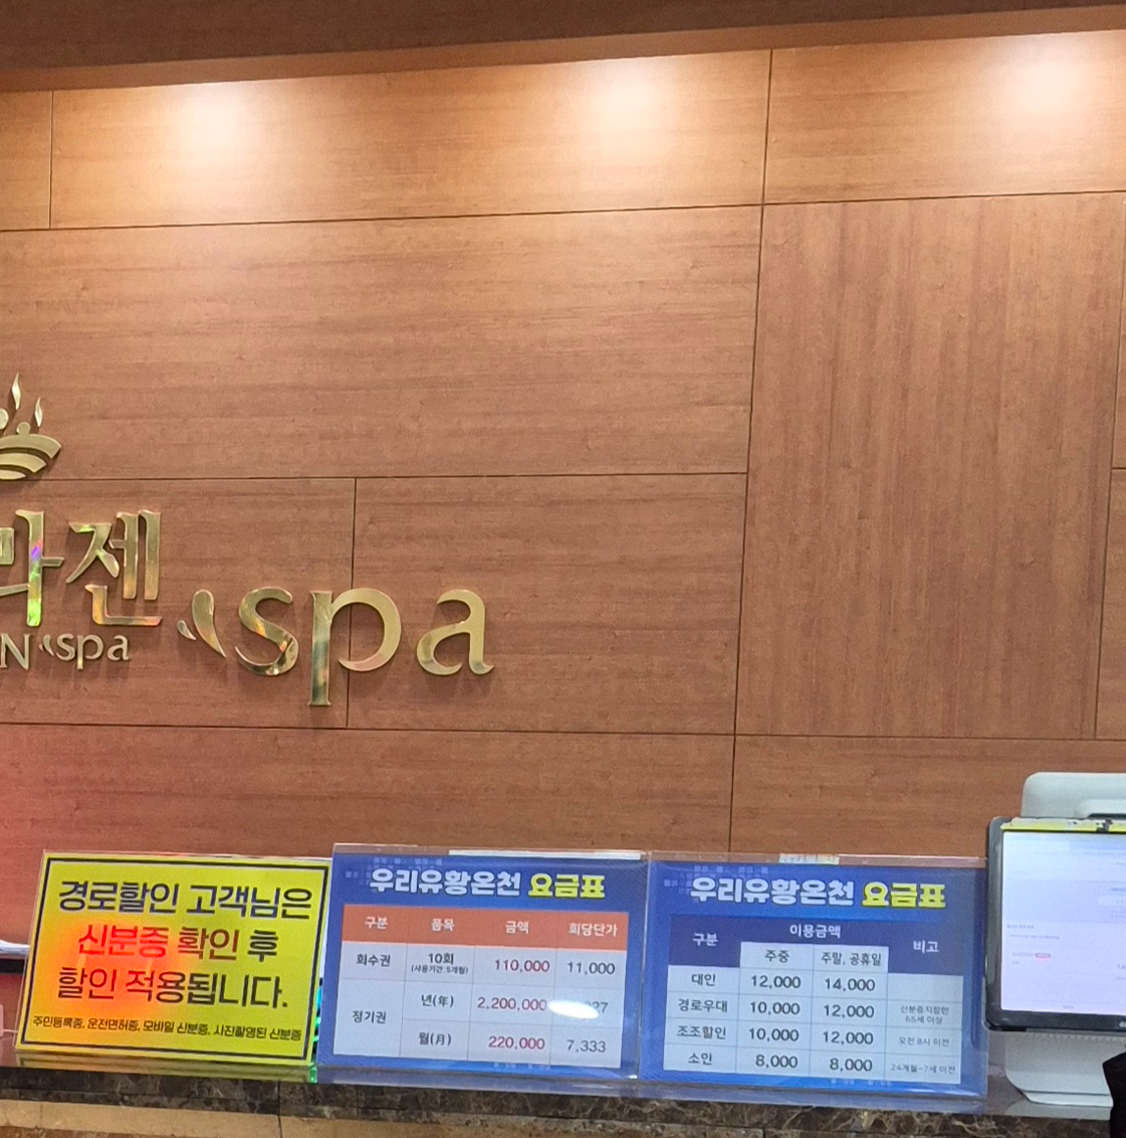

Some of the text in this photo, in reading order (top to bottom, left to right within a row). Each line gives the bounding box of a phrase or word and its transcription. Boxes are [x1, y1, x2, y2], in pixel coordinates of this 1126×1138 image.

[234, 586, 495, 707] spa
[369, 867, 606, 899] 우리유황온천 요금표
[690, 876, 947, 909] 우리유황온천 요금표
[59, 880, 313, 920] 경로할인 고객님은
[364, 916, 618, 937] 구분 품목 금액 회당단가
[789, 923, 842, 939] 이용금액
[78, 924, 278, 962] 신분증 확인 후
[692, 932, 939, 954] 구분 비고
[355, 952, 616, 976] 회수권 10회 110,000 11,000
[764, 949, 882, 967] 주중 주말, 공휴일
[58, 967, 288, 1009] 할인 적용됩니다.
[691, 973, 876, 993] 대인 12,000 14,000
[477, 996, 549, 1012] 2,200,000
[678, 998, 875, 1020] 경로우대 10,000 12,000
[352, 1010, 387, 1024] 정기권
[87, 1018, 140, 1031] 운전면허증,
[143, 1020, 174, 1033] 모바일
[177, 1022, 211, 1036] 신분증,
[269, 1027, 302, 1041] 신분증
[676, 1024, 874, 1046] 조조할인 10,000 12,000
[488, 1036, 545, 1051] 220,000
[566, 1039, 607, 1054] 7,333
[688, 1051, 873, 1073] 소인 8,000 8,000
